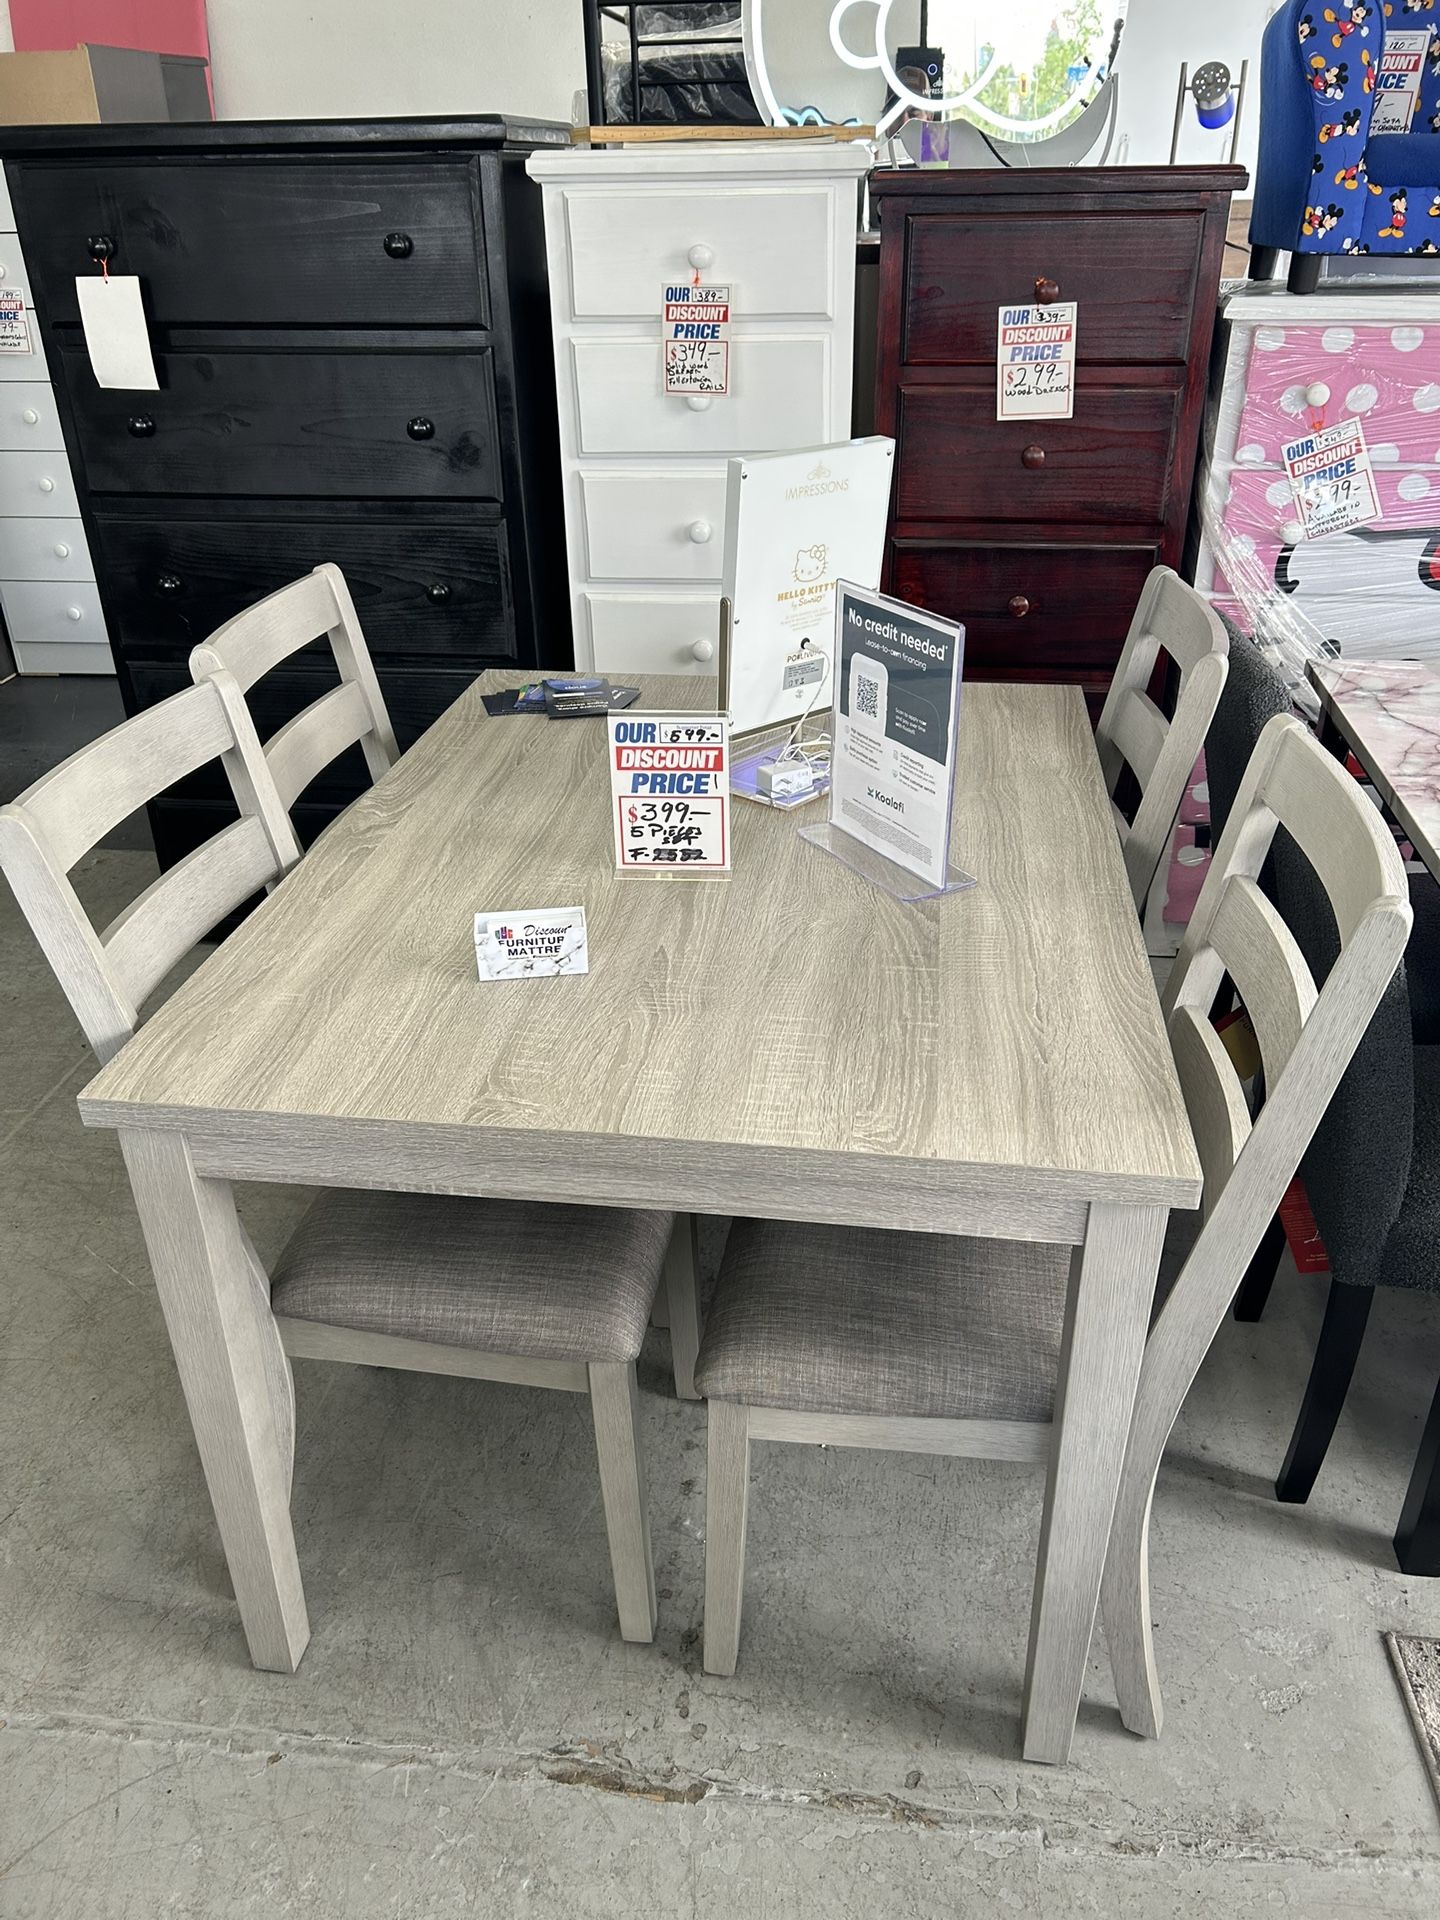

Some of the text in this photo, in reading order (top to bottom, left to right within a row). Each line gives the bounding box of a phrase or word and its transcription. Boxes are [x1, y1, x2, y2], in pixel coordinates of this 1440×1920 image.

[666, 286, 690, 302] OUR
[668, 306, 726, 320] DISCOUNT
[1003, 309, 1030, 326] OUR
[673, 323, 720, 339] PRICE
[1005, 327, 1070, 344] DISCOUNT
[1010, 344, 1063, 362] PRICE
[1287, 439, 1314, 461] OUR
[1294, 441, 1358, 476] DISCOUNT
[1303, 458, 1356, 490] PRICE
[785, 478, 849, 501] IMPRESSIONS
[777, 581, 836, 602] HELLO KITTY
[848, 607, 863, 627] No
[864, 618, 898, 642] credit
[901, 651, 927, 672] financing
[615, 722, 657, 743] OUR
[620, 749, 719, 769] DISCOUNT
[631, 773, 710, 794] PRICE
[875, 790, 904, 814] Koalafi
